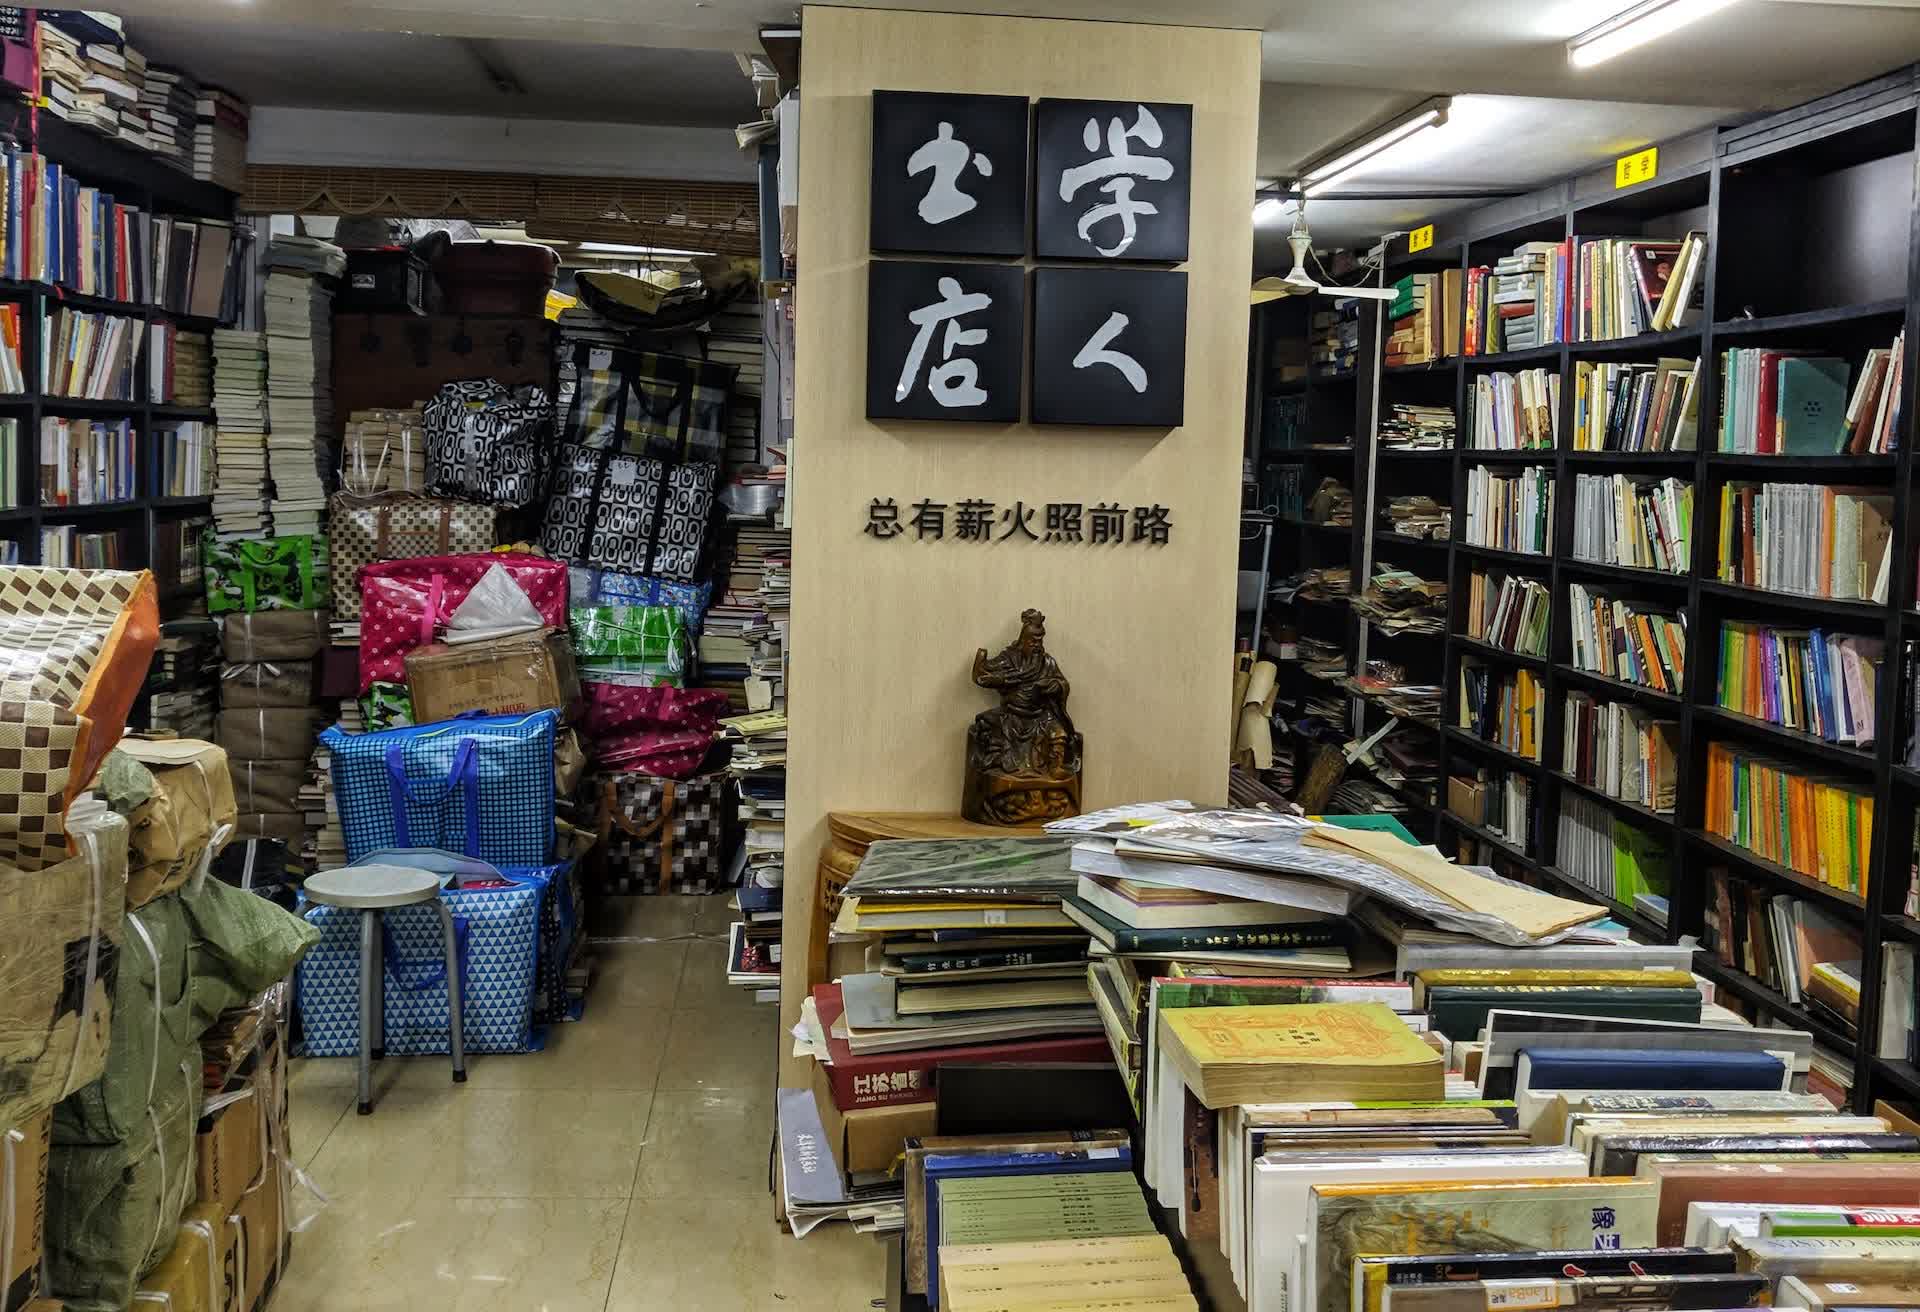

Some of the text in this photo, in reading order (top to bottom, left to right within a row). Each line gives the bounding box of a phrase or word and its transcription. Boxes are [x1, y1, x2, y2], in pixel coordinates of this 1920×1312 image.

[864, 498, 1173, 546] 总有薪火照前路
